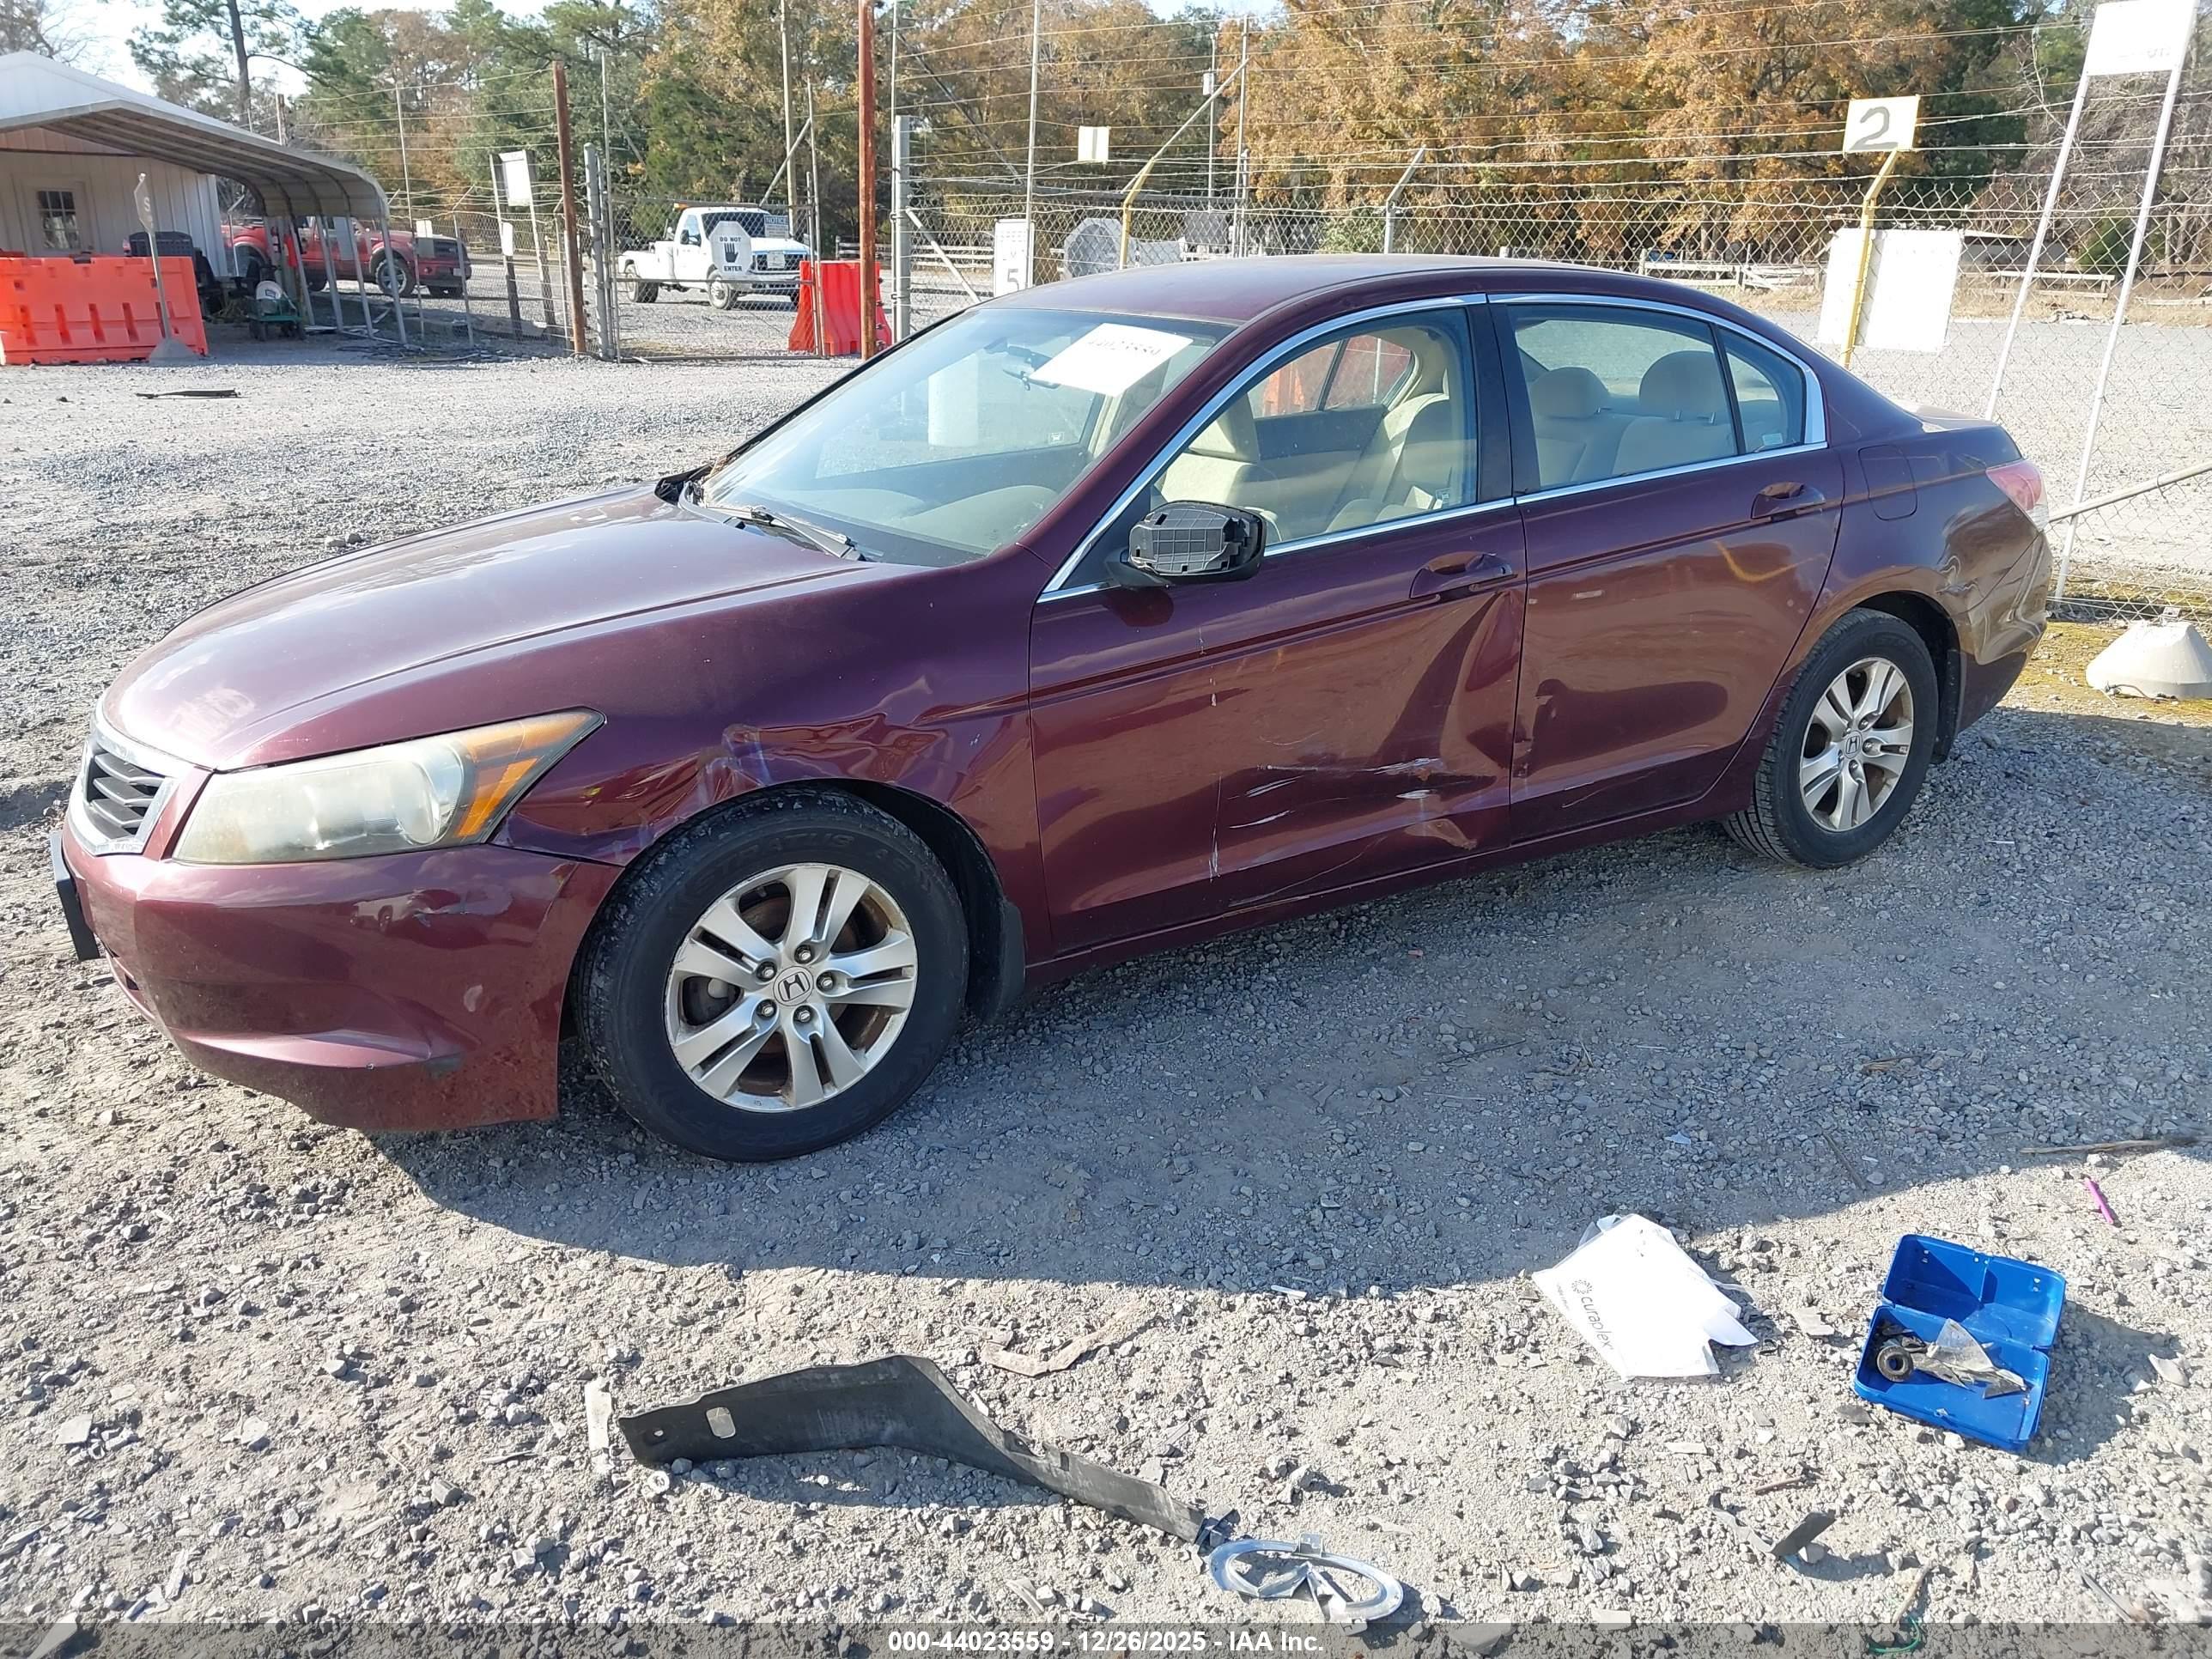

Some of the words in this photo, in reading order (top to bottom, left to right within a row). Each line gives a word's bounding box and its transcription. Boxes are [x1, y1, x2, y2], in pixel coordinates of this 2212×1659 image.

[1849, 106, 1899, 150] 2
[1007, 268, 1019, 291] 5
[1581, 1297, 1613, 1348] curaplex
